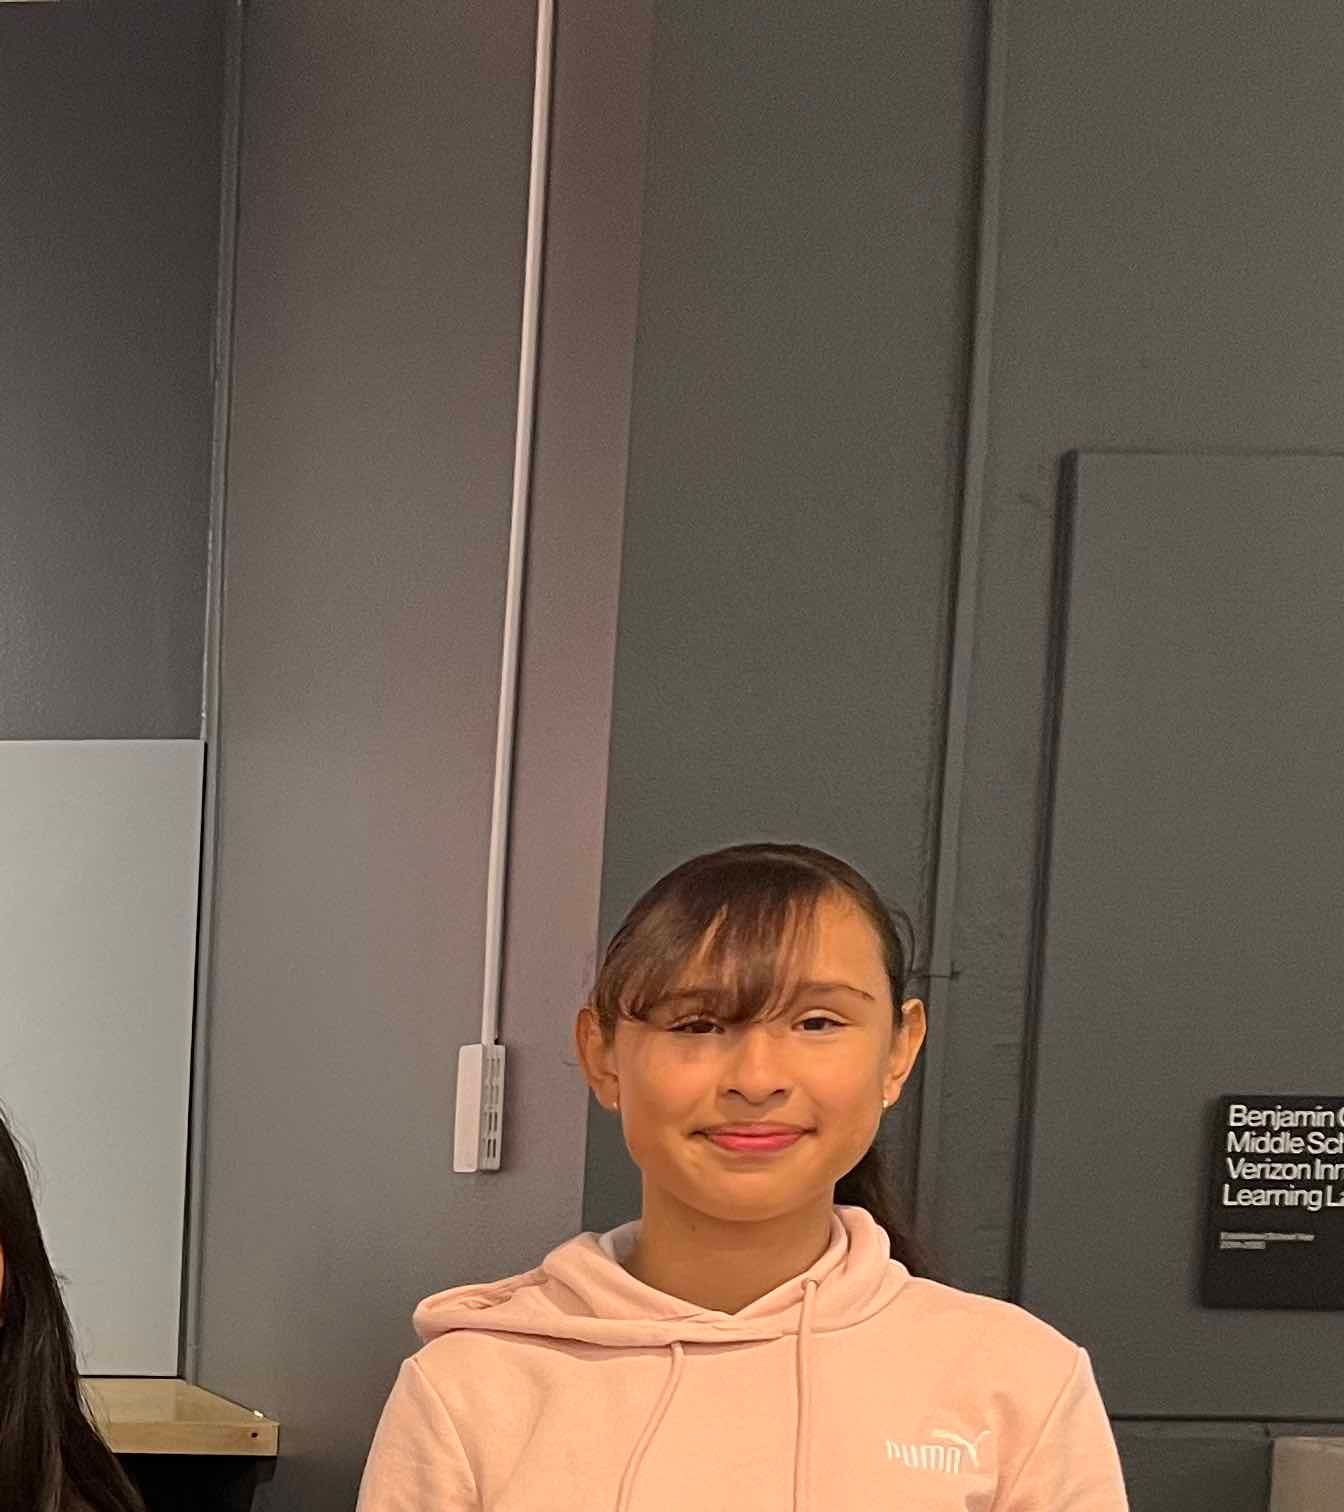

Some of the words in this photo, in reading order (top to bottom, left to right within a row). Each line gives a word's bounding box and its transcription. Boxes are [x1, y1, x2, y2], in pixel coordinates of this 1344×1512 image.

[1228, 1104, 1335, 1131] Benjamin
[1227, 1131, 1305, 1154] Middle
[1226, 1157, 1311, 1180] Verizon
[1222, 1183, 1323, 1211] Learning
